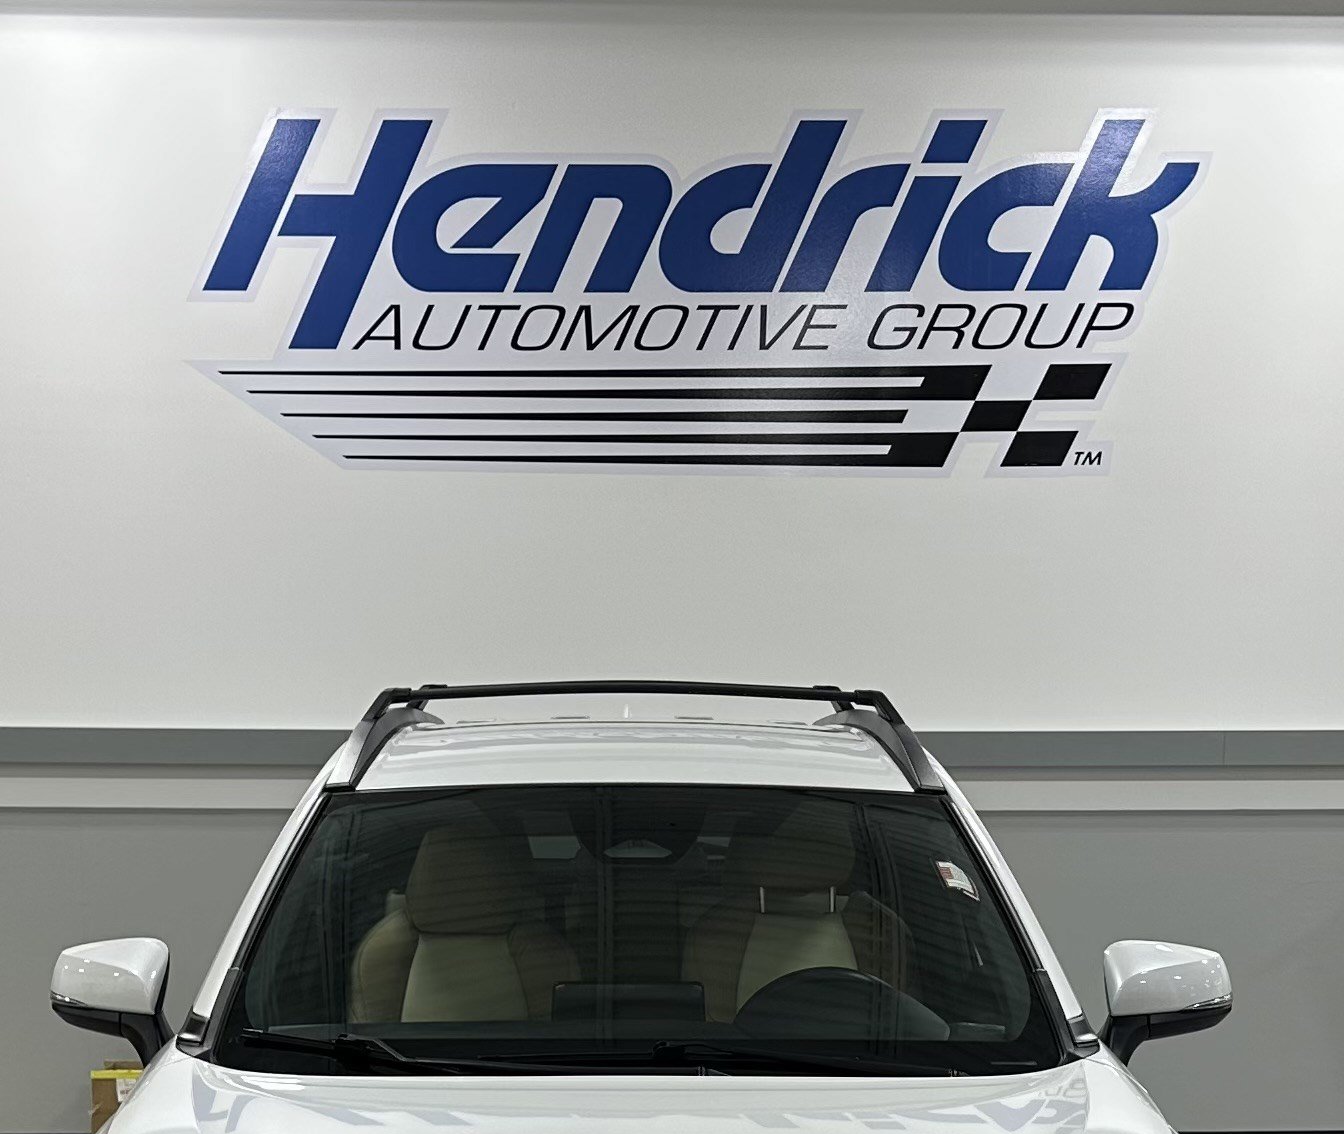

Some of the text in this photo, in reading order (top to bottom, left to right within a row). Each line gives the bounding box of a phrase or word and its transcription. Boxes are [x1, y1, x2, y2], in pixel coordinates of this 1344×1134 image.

[204, 118, 1200, 350] Hendrick
[352, 301, 1135, 352] AUTOMOTIVE GROUP
[1073, 450, 1103, 466] TM
